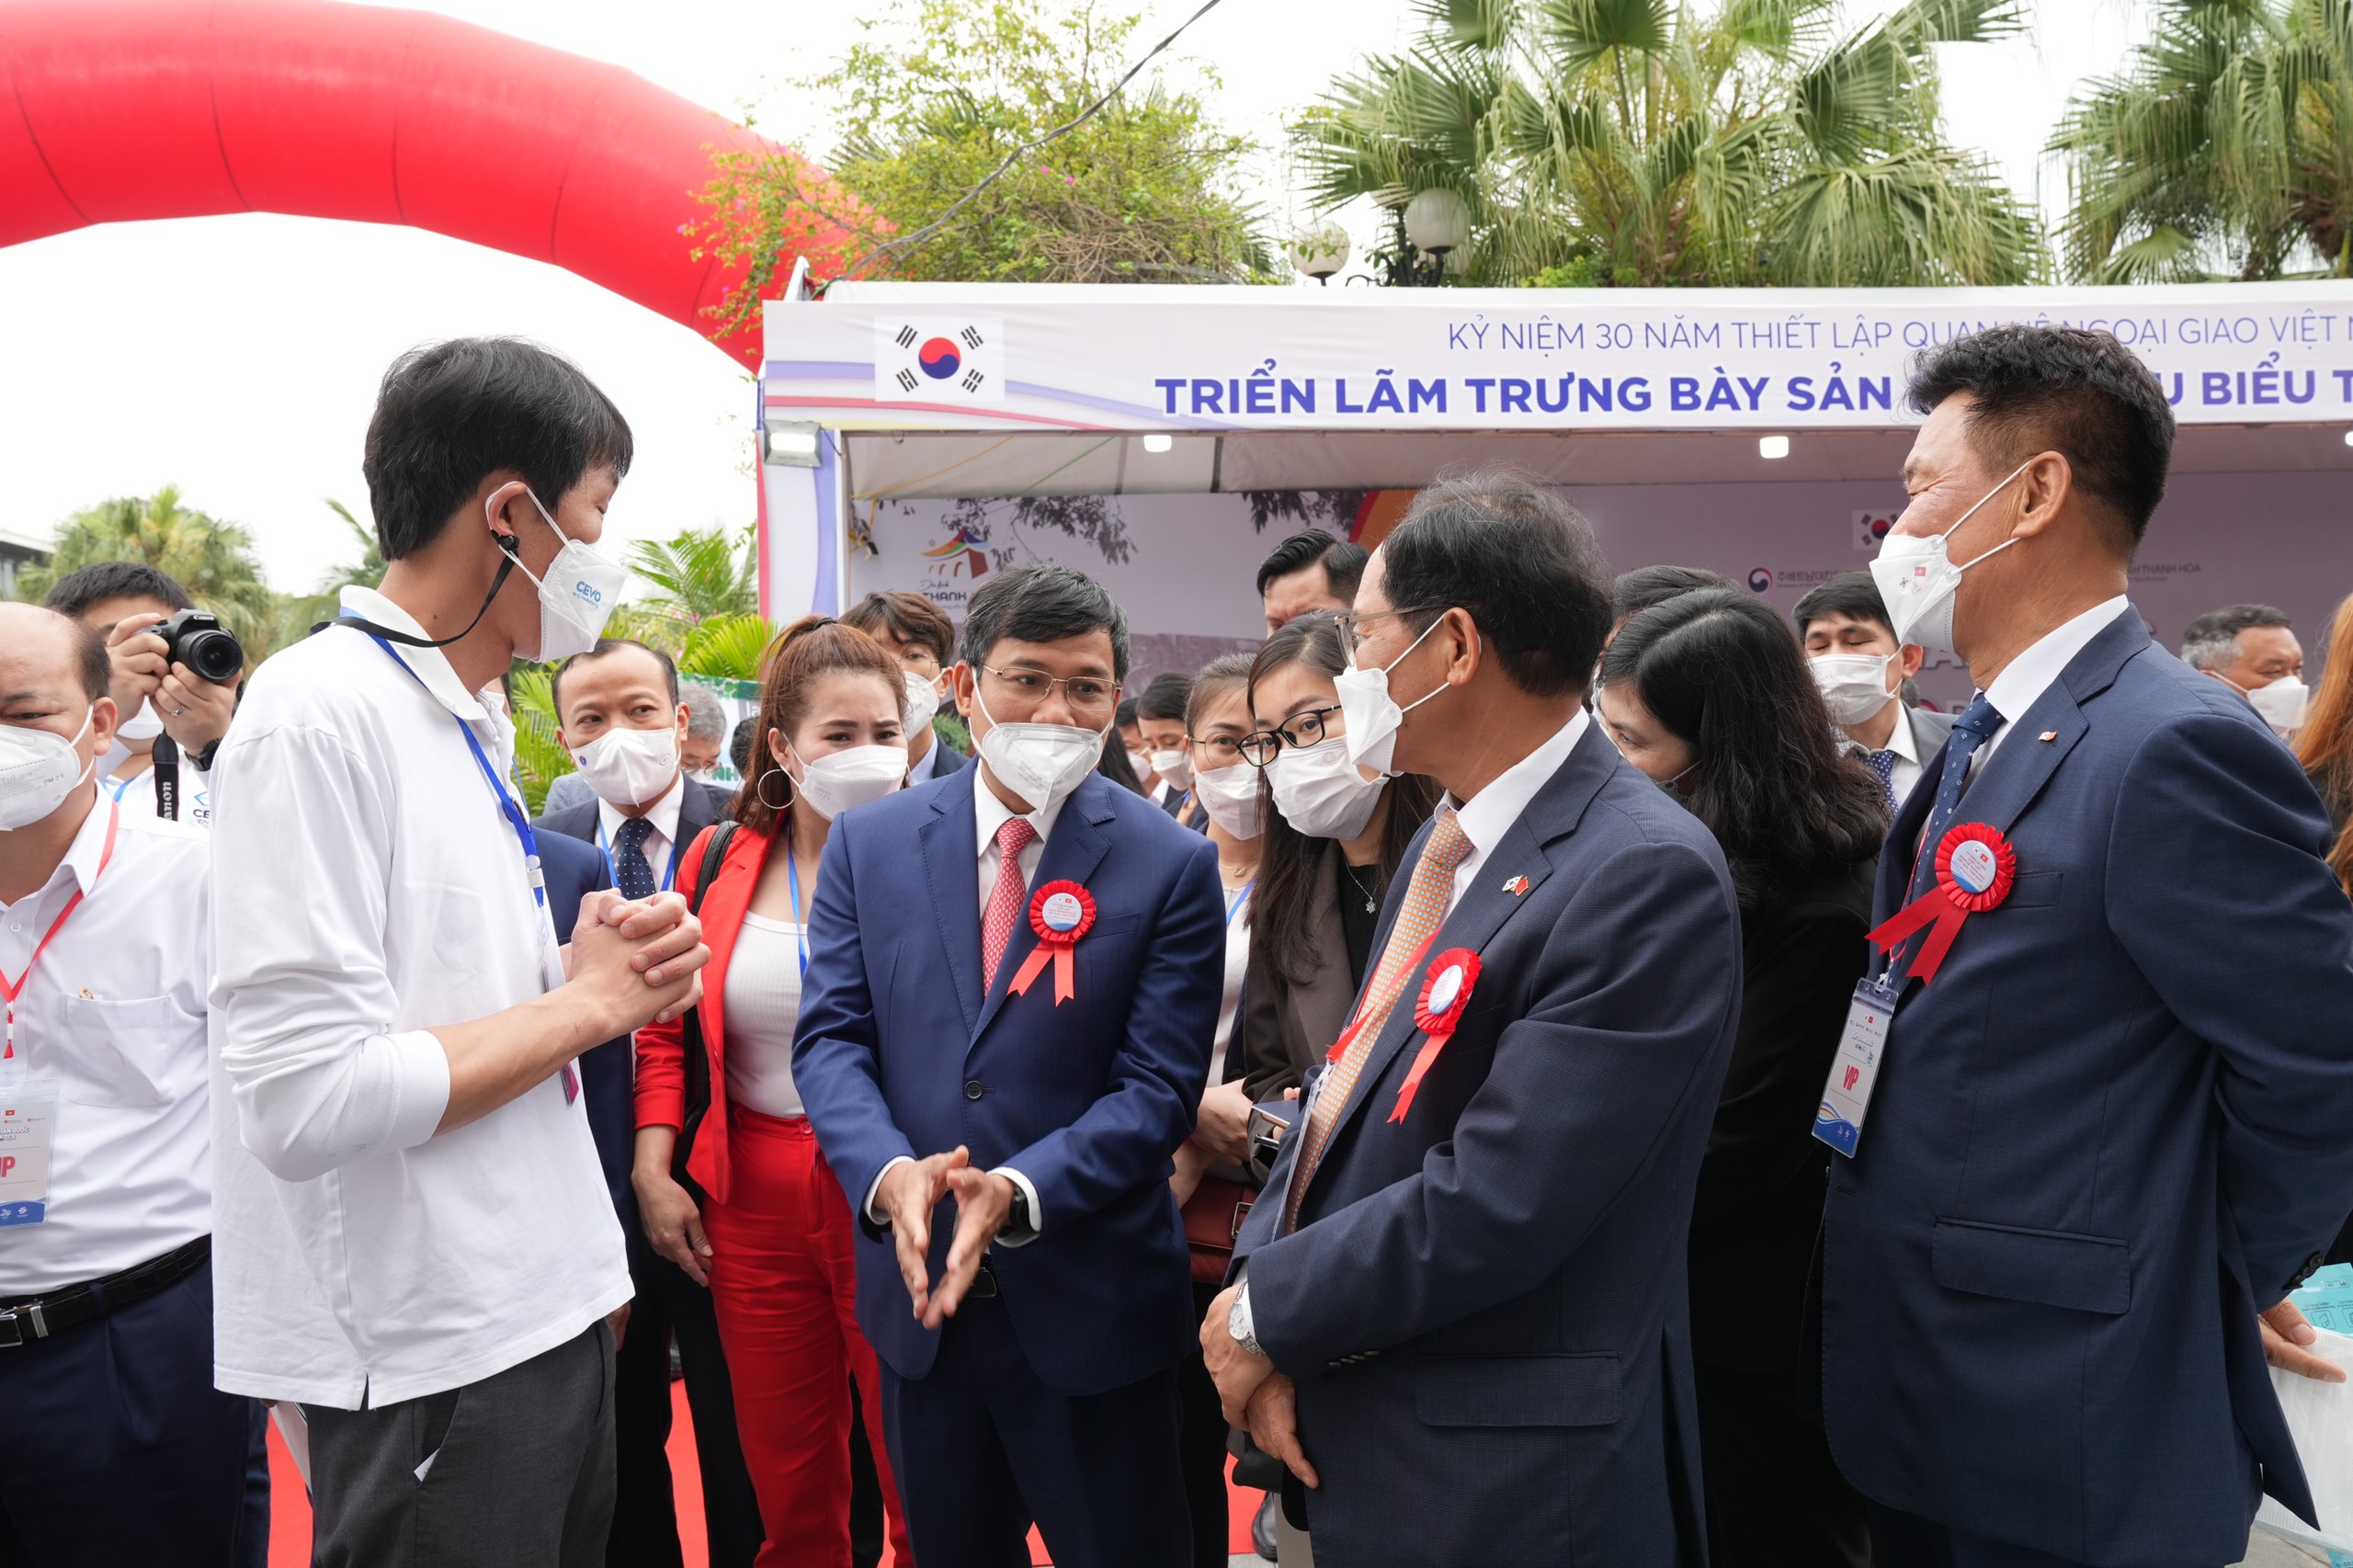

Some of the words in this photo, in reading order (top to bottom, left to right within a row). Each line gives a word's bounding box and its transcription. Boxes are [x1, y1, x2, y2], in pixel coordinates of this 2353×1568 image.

[1449, 314, 1489, 350] KỶ
[1502, 314, 1585, 357] NIỆM
[1597, 323, 1633, 349] 30
[1645, 314, 1721, 349] NĂM
[1731, 313, 1819, 349] THIẾT
[1833, 314, 1892, 356] LẬP
[2063, 316, 2166, 352] OẠI
[2178, 317, 2258, 345] GIAO
[2268, 308, 2337, 350] VIỆT
[1154, 358, 1316, 414] TRIỂN
[1335, 369, 1447, 414] LÃM
[1464, 371, 1652, 413] TRƯNG
[1670, 366, 1769, 412] BÀY
[1786, 361, 1892, 411] SẢN
[2202, 351, 2315, 405] BIỂU
[575, 581, 602, 602] CEVO
[162, 781, 173, 820] anon
[1843, 1064, 1859, 1092] VIP
